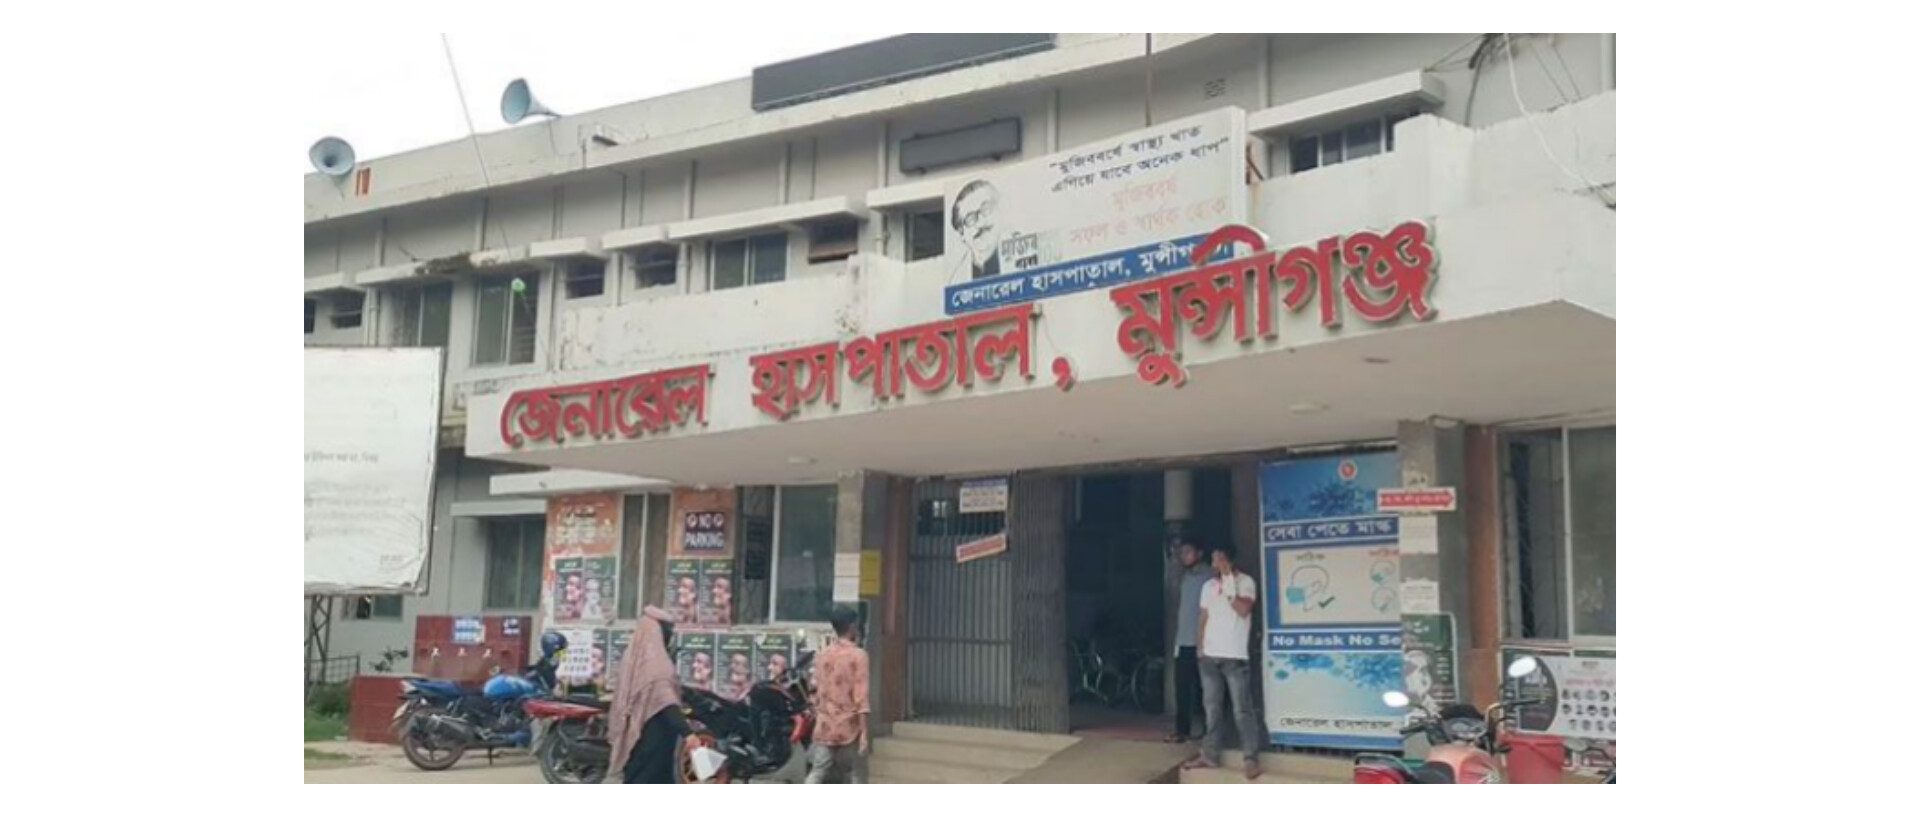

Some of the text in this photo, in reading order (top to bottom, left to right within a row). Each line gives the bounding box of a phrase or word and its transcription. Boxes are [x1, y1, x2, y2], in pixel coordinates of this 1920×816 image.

[951, 278, 1025, 308] জেনারেল
[499, 364, 712, 448] জেনারেল
[1109, 219, 1438, 388] মুন্সীগঞ্জ
[698, 513, 713, 529] NO
[685, 530, 726, 549] PARKING
[1273, 635, 1295, 647] No
[1299, 634, 1344, 647] Mask
[1348, 634, 1373, 646] No
